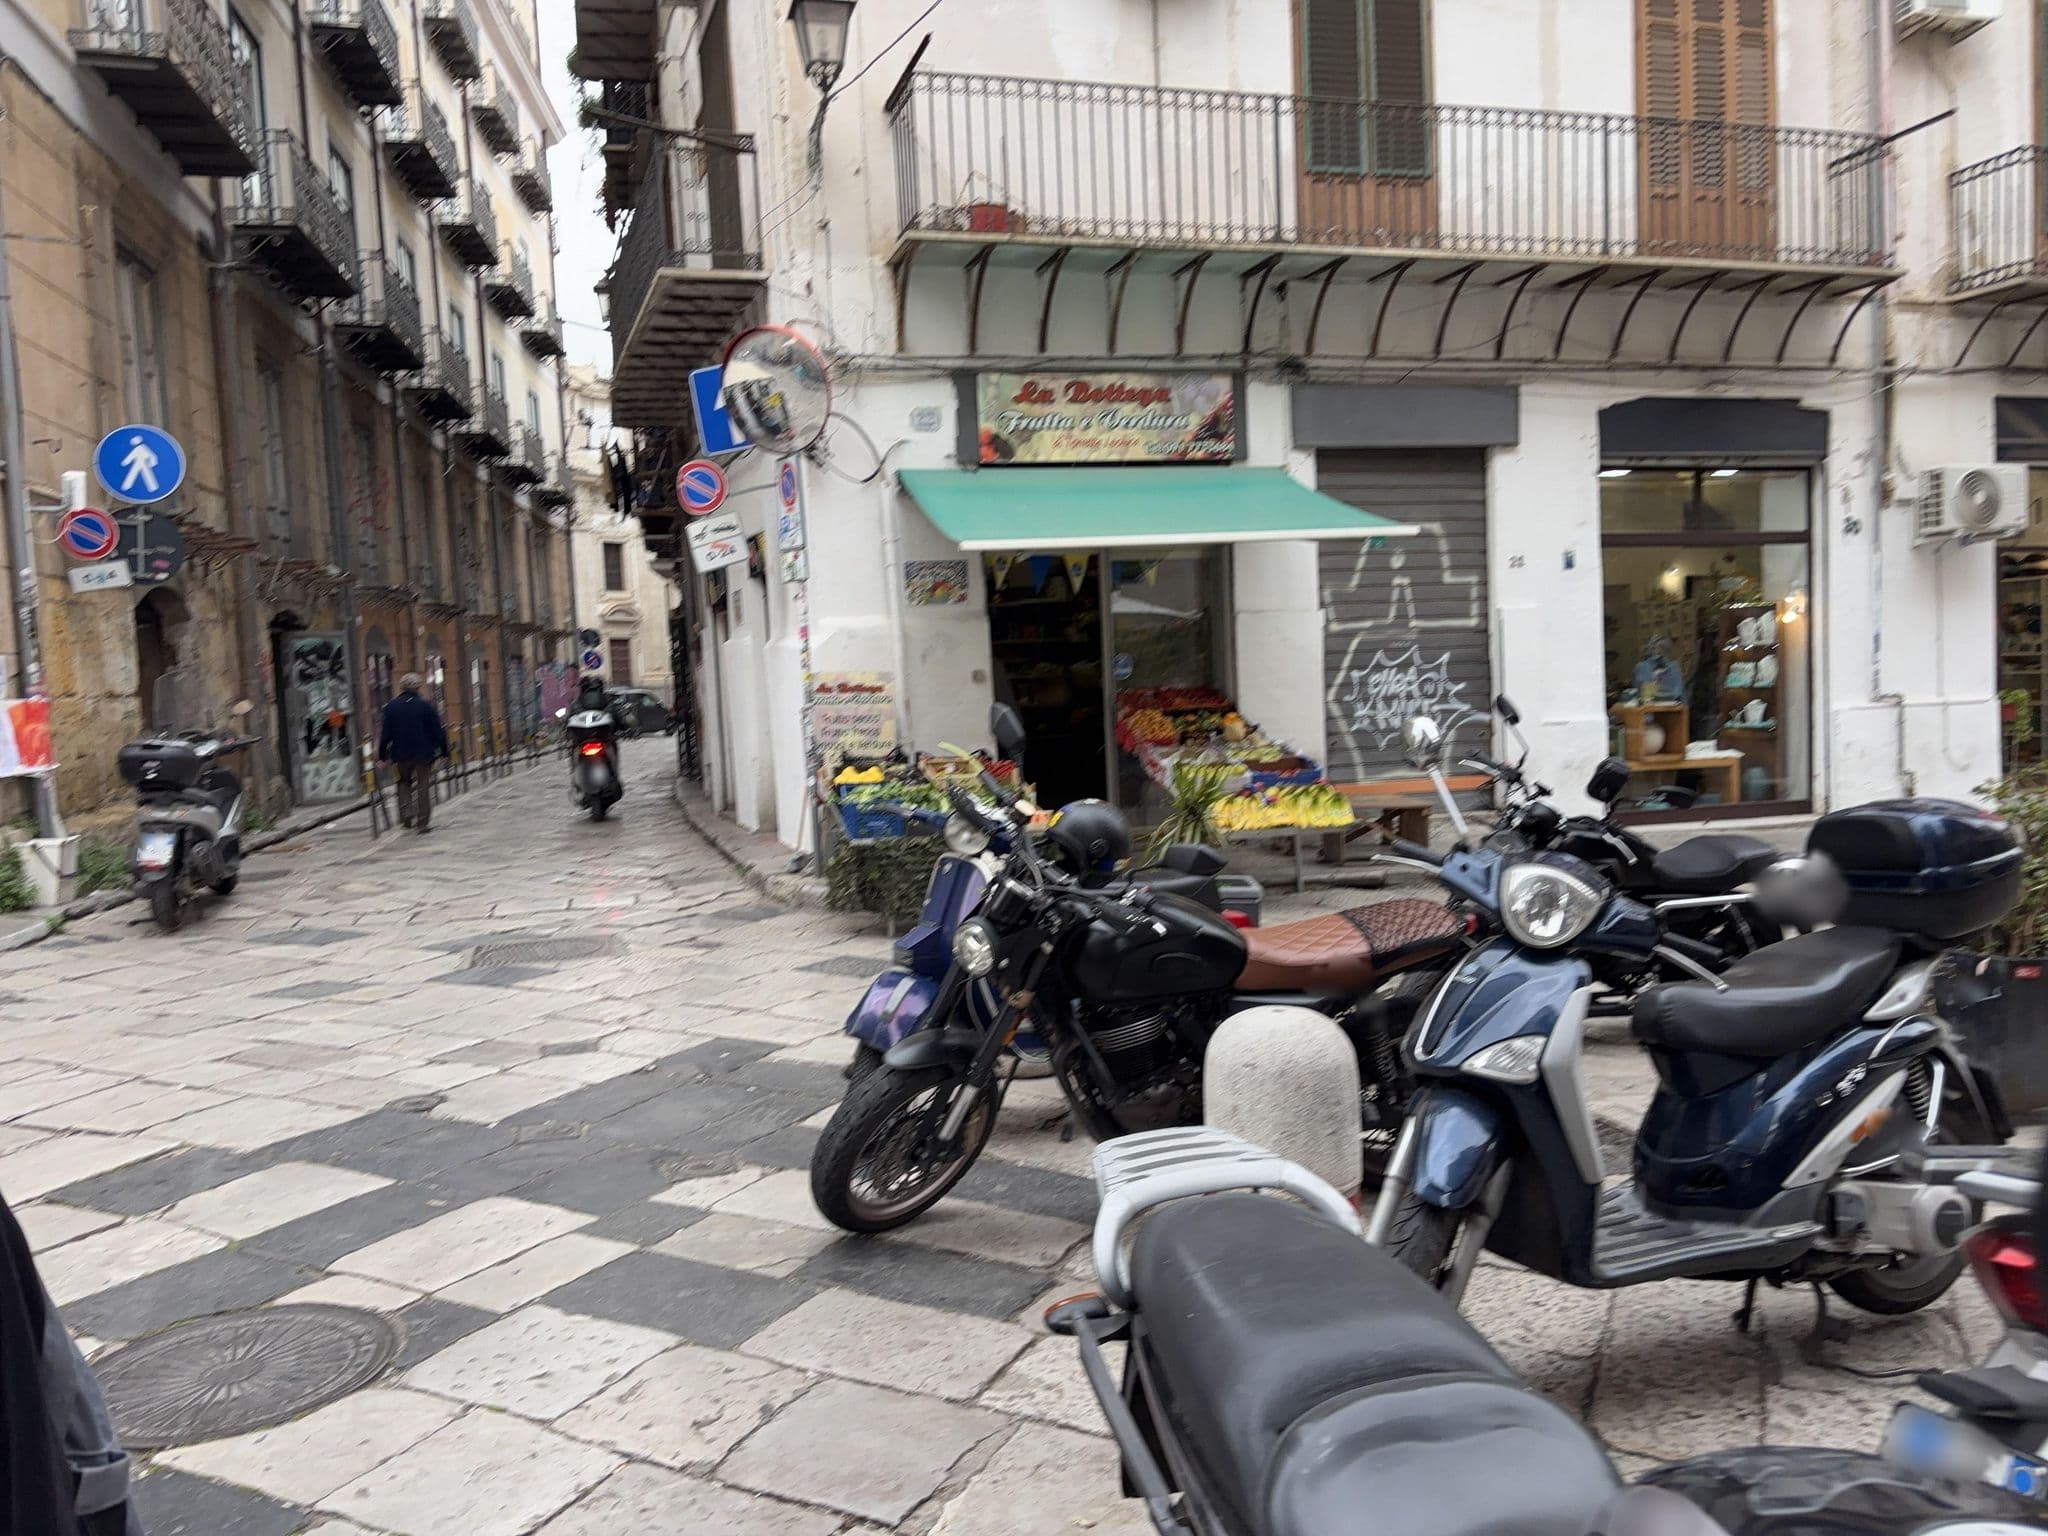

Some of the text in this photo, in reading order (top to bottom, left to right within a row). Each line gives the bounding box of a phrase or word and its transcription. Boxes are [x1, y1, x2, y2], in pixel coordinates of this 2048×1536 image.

[1011, 381, 1171, 408] La Bottega
[997, 406, 1189, 435] Frutta e Verdura
